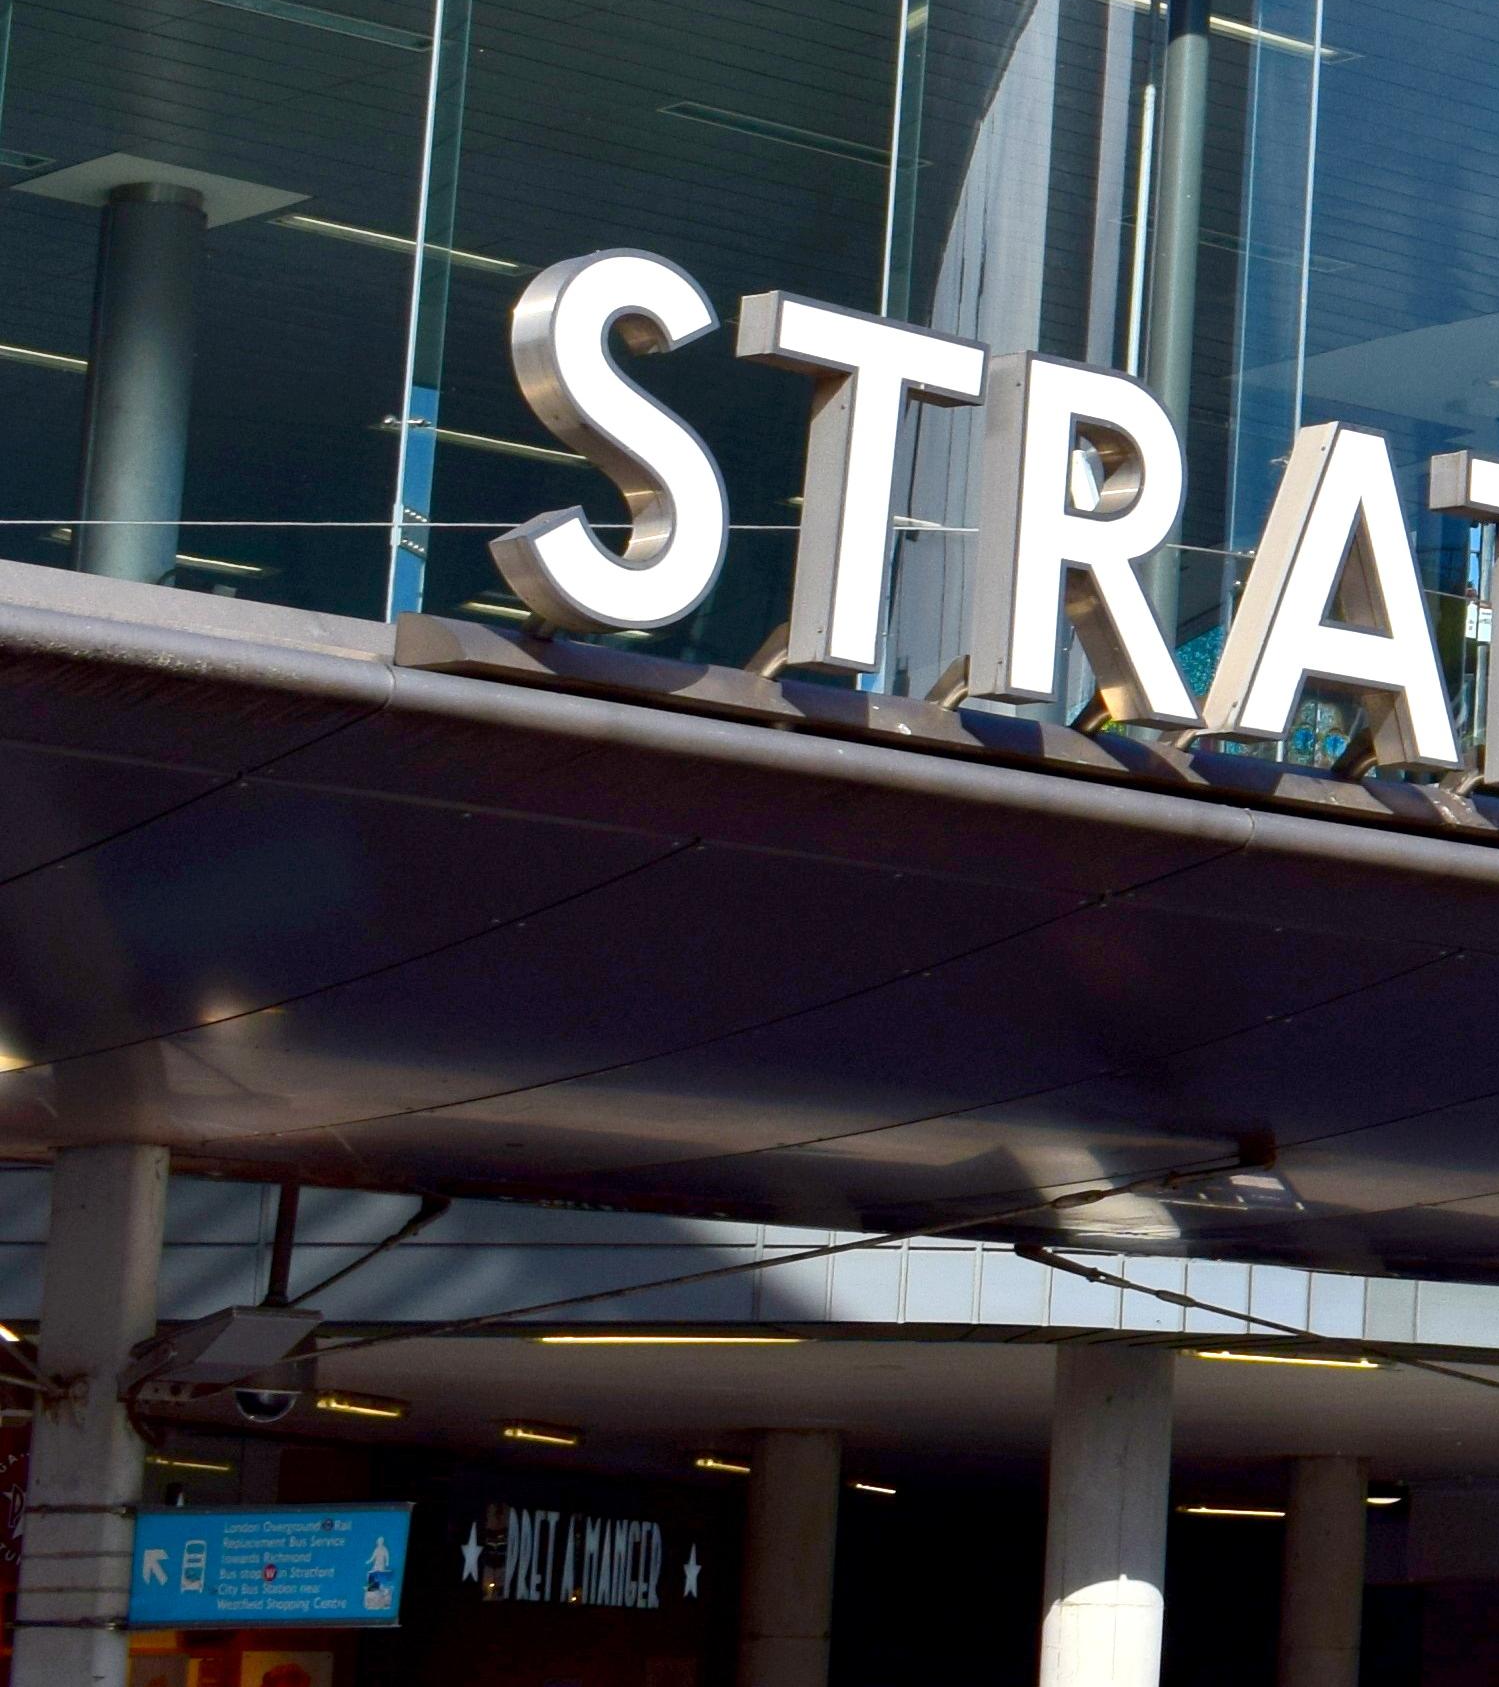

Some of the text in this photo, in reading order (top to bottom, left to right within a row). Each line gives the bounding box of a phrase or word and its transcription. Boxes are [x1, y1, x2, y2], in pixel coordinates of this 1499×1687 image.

[223, 1519, 260, 1534] London
[262, 1519, 322, 1535] Overground
[222, 1534, 346, 1548] Replacement Bus Service
[263, 1551, 312, 1564] Richmond
[503, 1506, 560, 1602] PRET
[580, 1515, 662, 1610] MANGER
[219, 1567, 237, 1580] Bus
[289, 1566, 336, 1579] Stratford
[217, 1582, 238, 1596] City
[241, 1583, 259, 1595] Bus
[262, 1582, 297, 1595] Station
[216, 1596, 348, 1612] Westfield Shopping Centre
